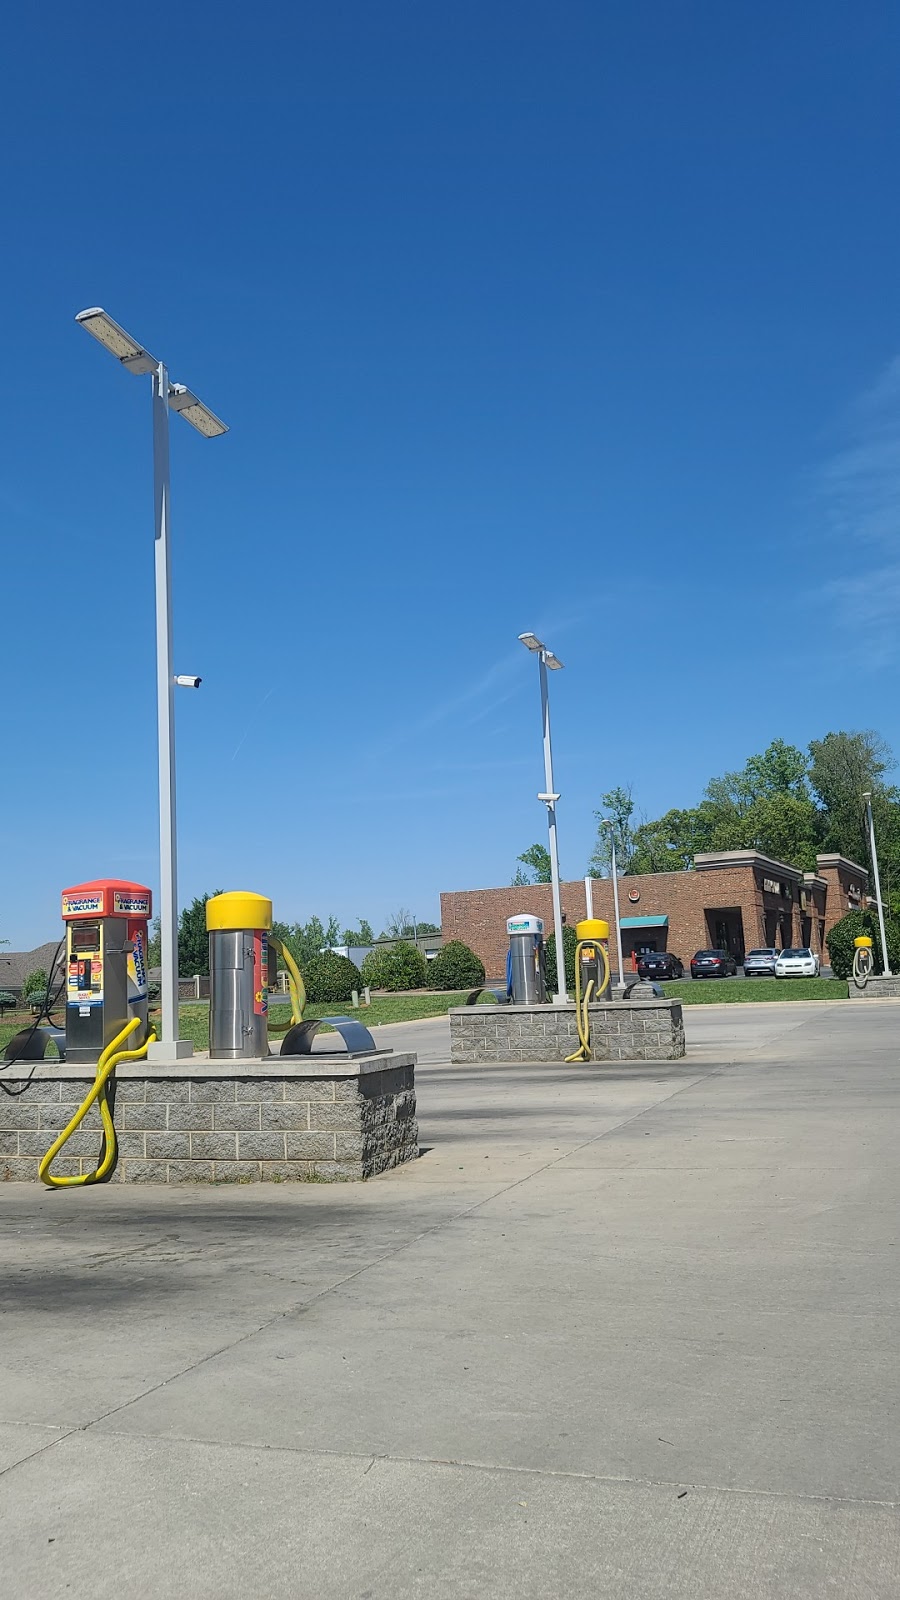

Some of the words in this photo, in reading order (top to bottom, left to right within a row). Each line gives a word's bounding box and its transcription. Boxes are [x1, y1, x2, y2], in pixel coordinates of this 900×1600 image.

[66, 897, 100, 906] FRAGRANCE
[118, 897, 148, 905] FRAGRANCE
[132, 949, 143, 987] VACUUM
